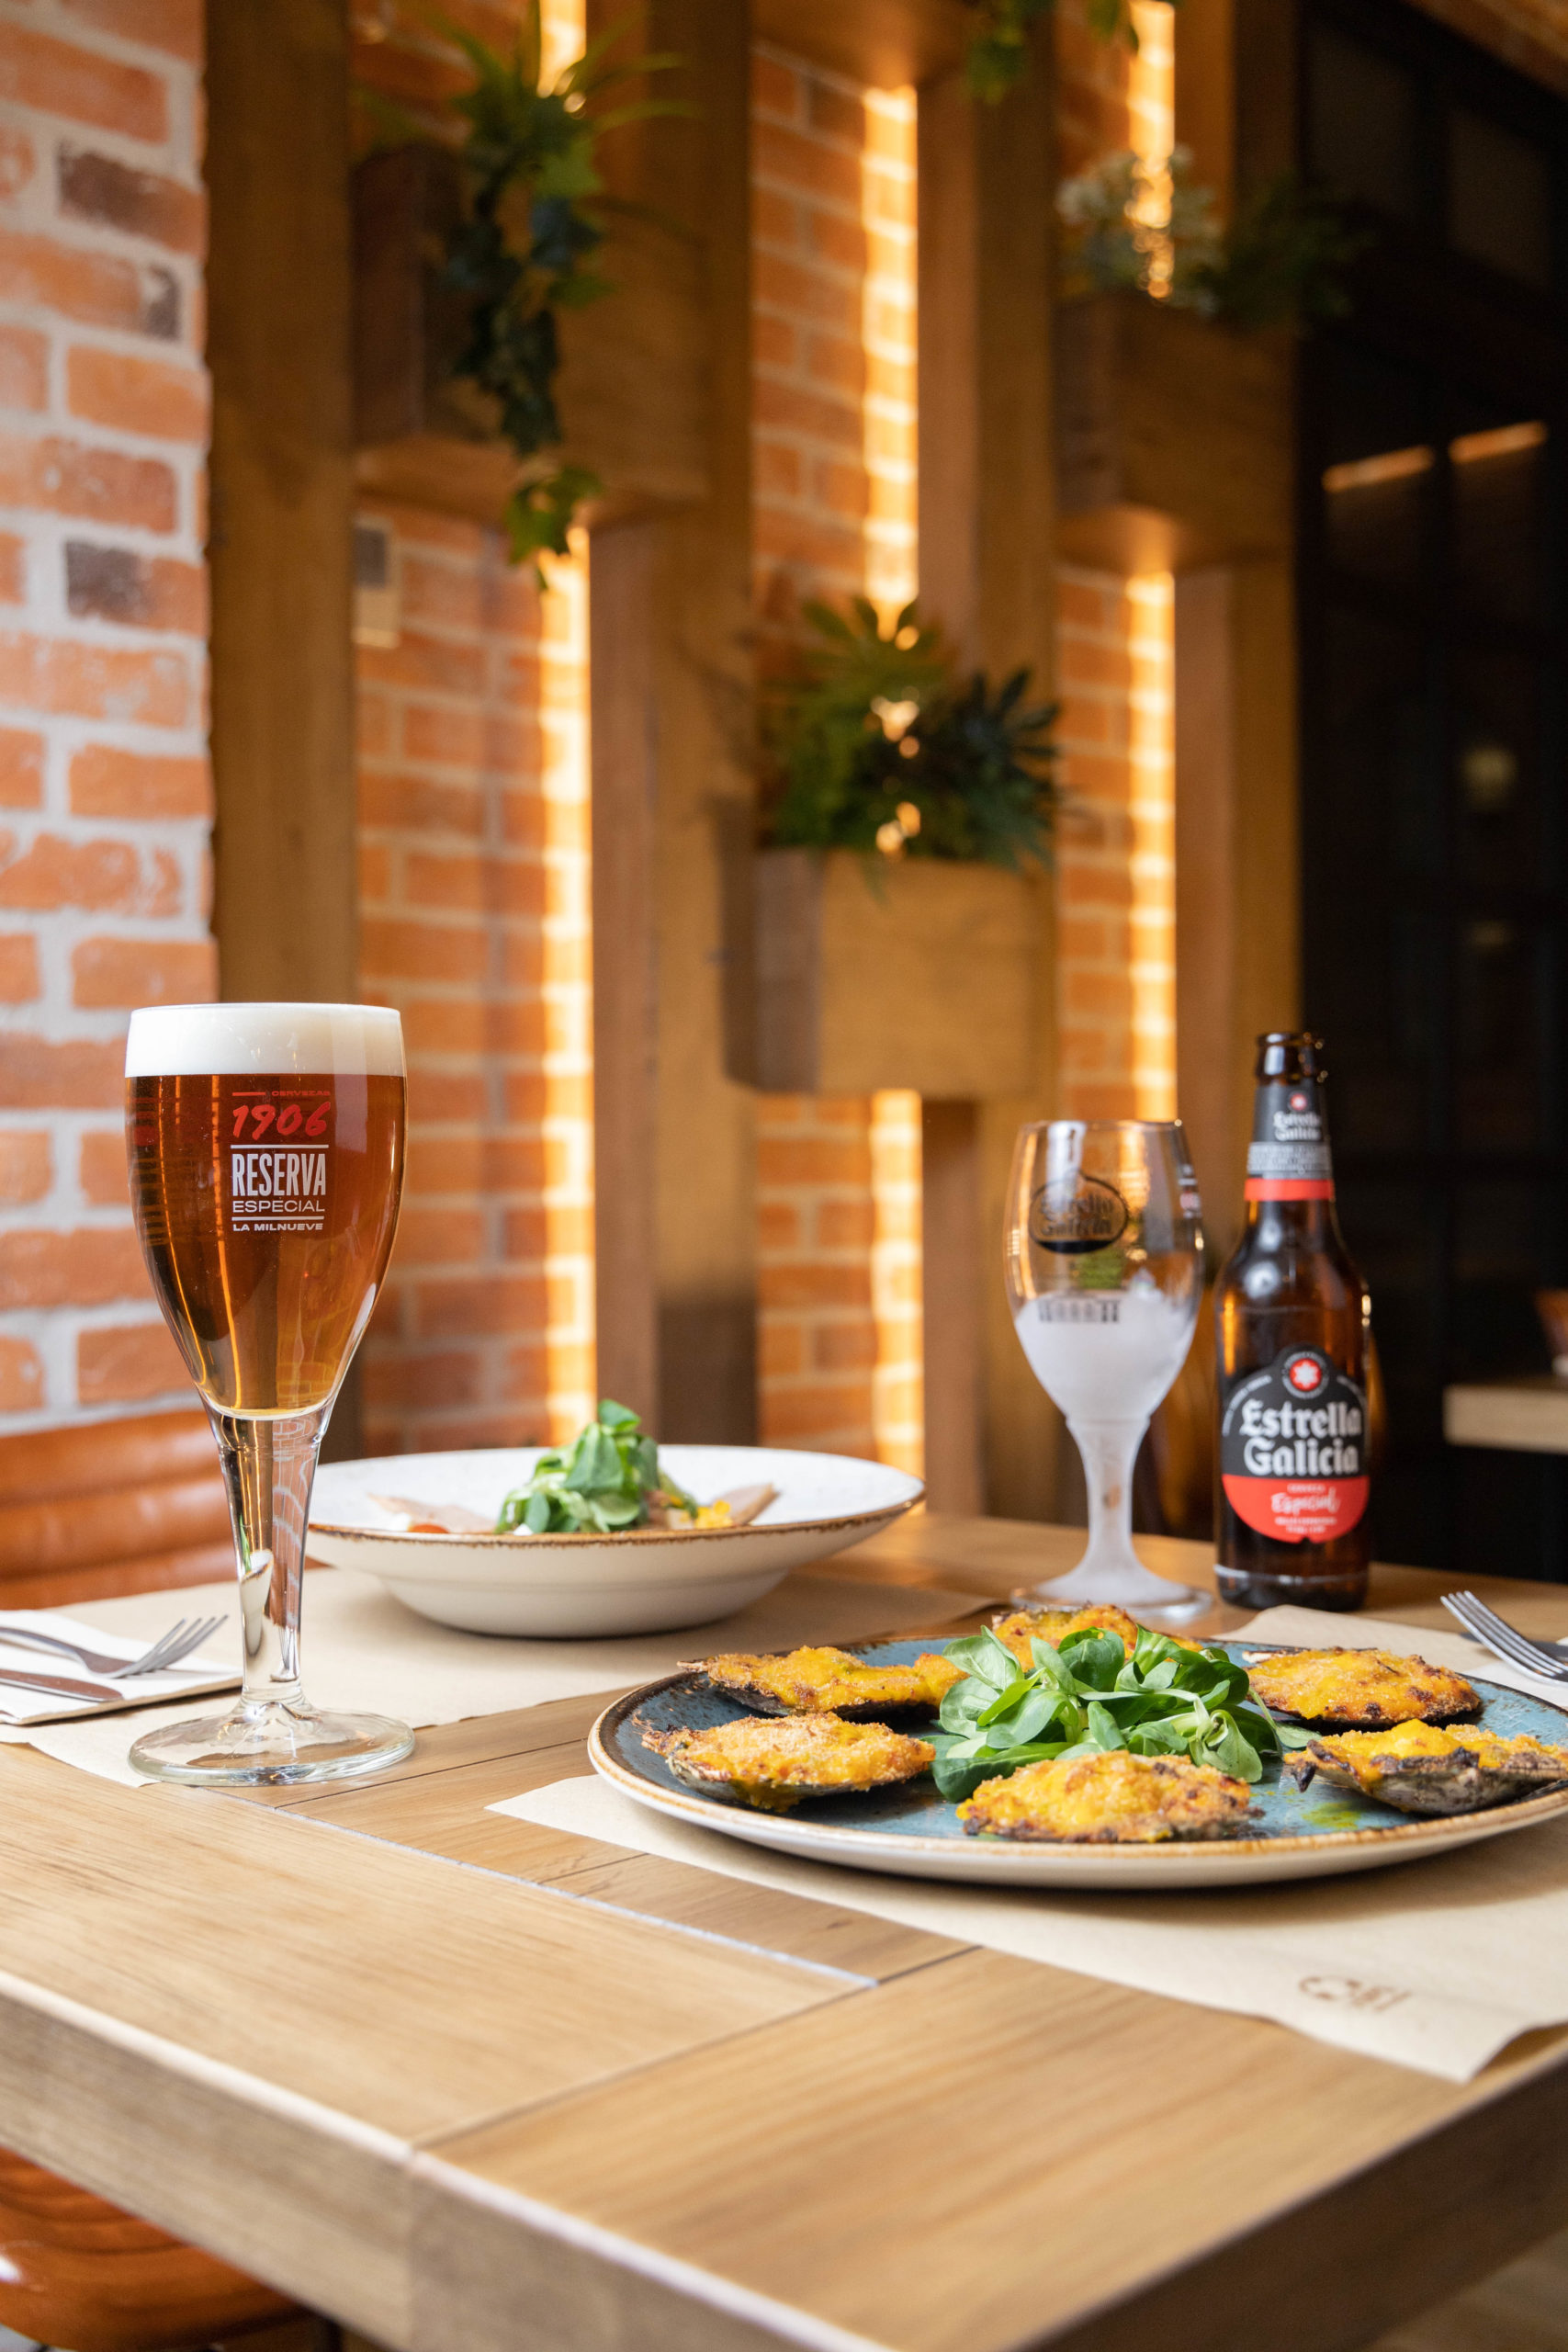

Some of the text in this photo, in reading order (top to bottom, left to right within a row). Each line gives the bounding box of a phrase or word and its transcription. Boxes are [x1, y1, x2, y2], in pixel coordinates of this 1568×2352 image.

[232, 1101, 331, 1141] 1906
[231, 1153, 326, 1196] RESERVA
[232, 1200, 325, 1213] ESPECIAL
[232, 1223, 323, 1232] LA MILNUEVE
[1239, 1398, 1362, 1439] Estrella
[1243, 1437, 1359, 1476] Galicia
